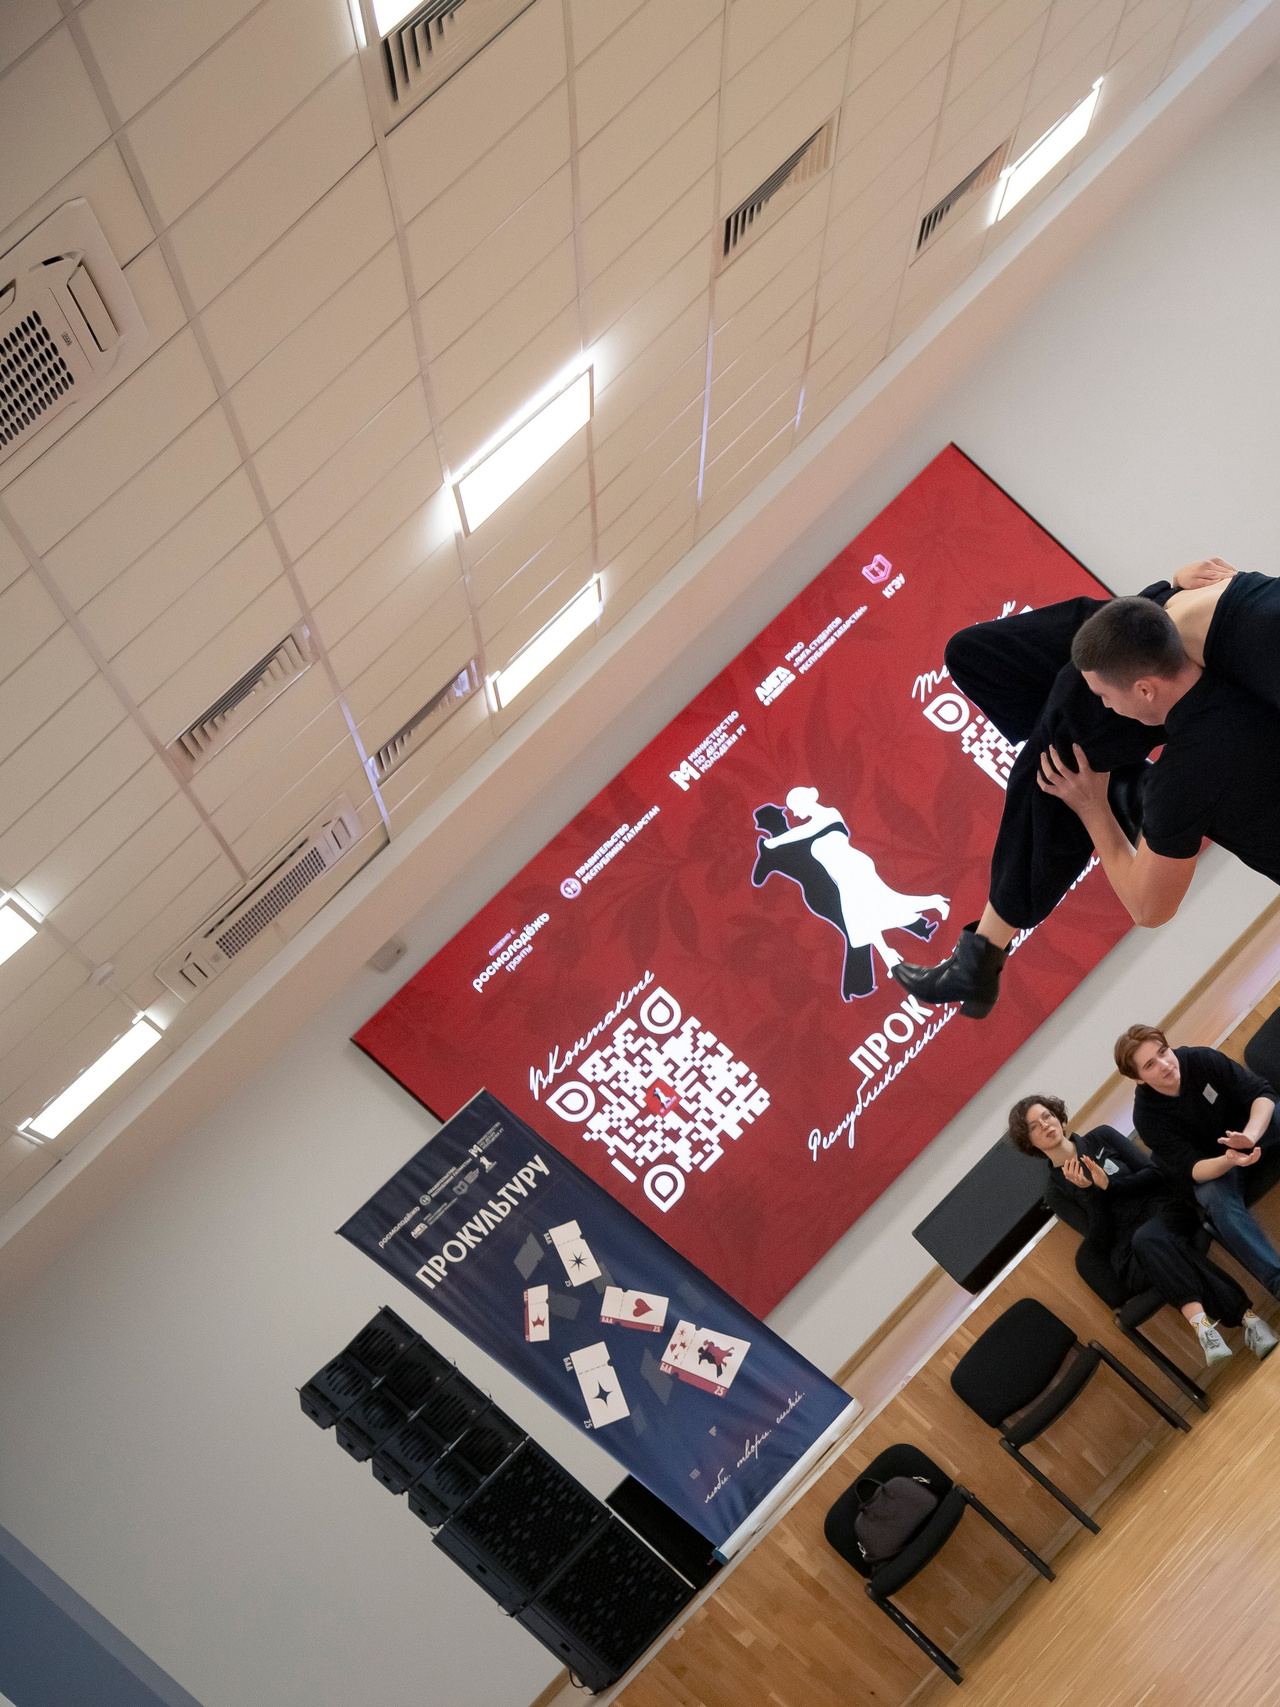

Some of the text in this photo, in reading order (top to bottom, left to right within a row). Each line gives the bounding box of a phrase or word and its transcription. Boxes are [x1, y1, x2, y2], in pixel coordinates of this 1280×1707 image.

[881, 572, 905, 599] КГЭУ
[687, 710, 739, 762] МИНИСТЕРСТВО
[693, 732, 729, 768] ПО ДЕЛАМ
[696, 724, 747, 773] МОЛОДЕЖИ РТ
[574, 823, 630, 878] ПРАВИТЕЛЬСТВО
[579, 805, 660, 884] РЕСПУБЛИКИ ТАТАРСТАН
[472, 912, 550, 993] росмолодёжь
[505, 943, 533, 972] гранты
[529, 969, 655, 1101] ВКонтакте
[808, 1002, 957, 1162] Республиканский
[415, 1154, 550, 1290] ПРОКУЛЬТУРУ
[659, 1361, 673, 1375] БАЛ
[713, 1386, 725, 1397] 25
